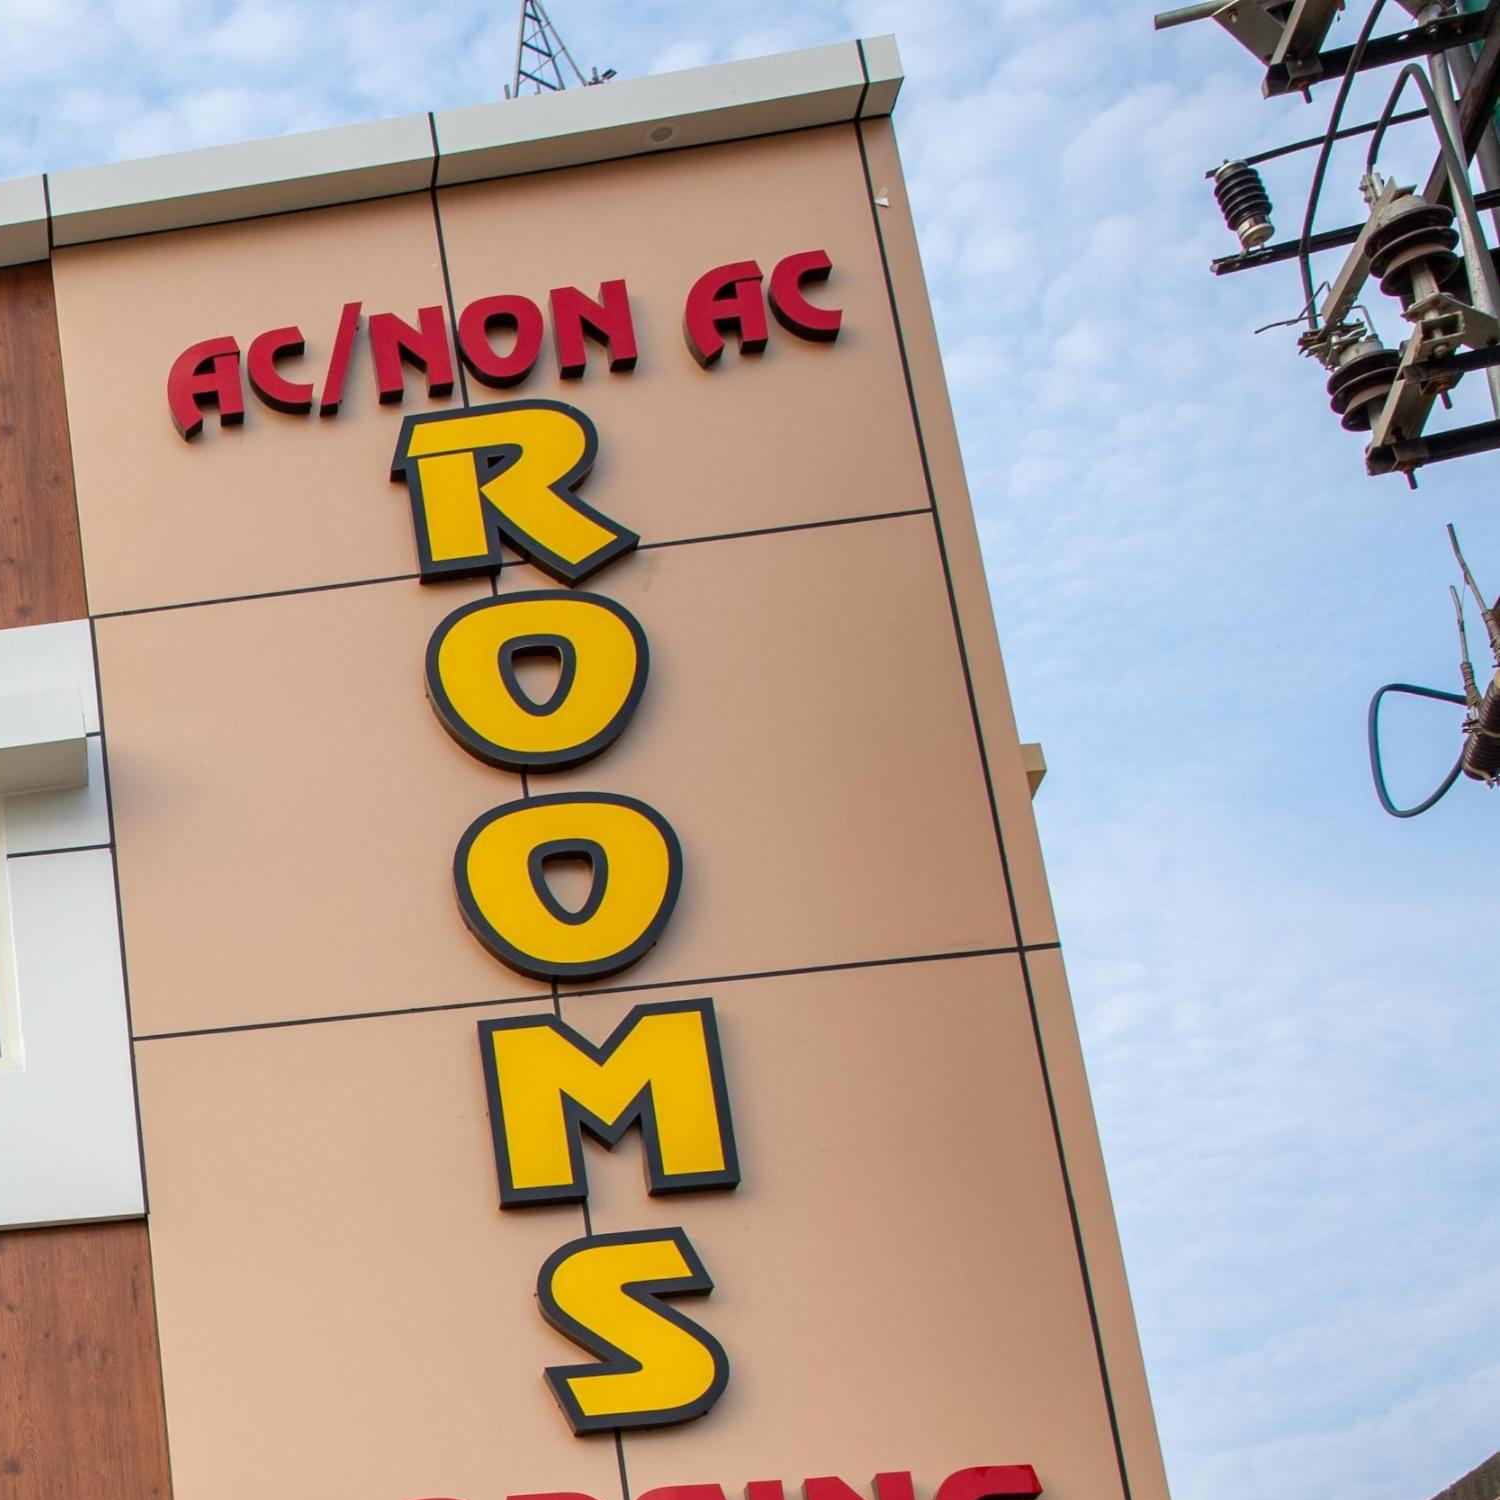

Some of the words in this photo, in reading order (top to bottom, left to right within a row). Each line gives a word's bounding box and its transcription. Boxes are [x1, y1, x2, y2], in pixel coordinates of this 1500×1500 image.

[166, 280, 638, 442] AC/NON
[683, 249, 842, 368] AC
[389, 397, 740, 1438] ROOMS
